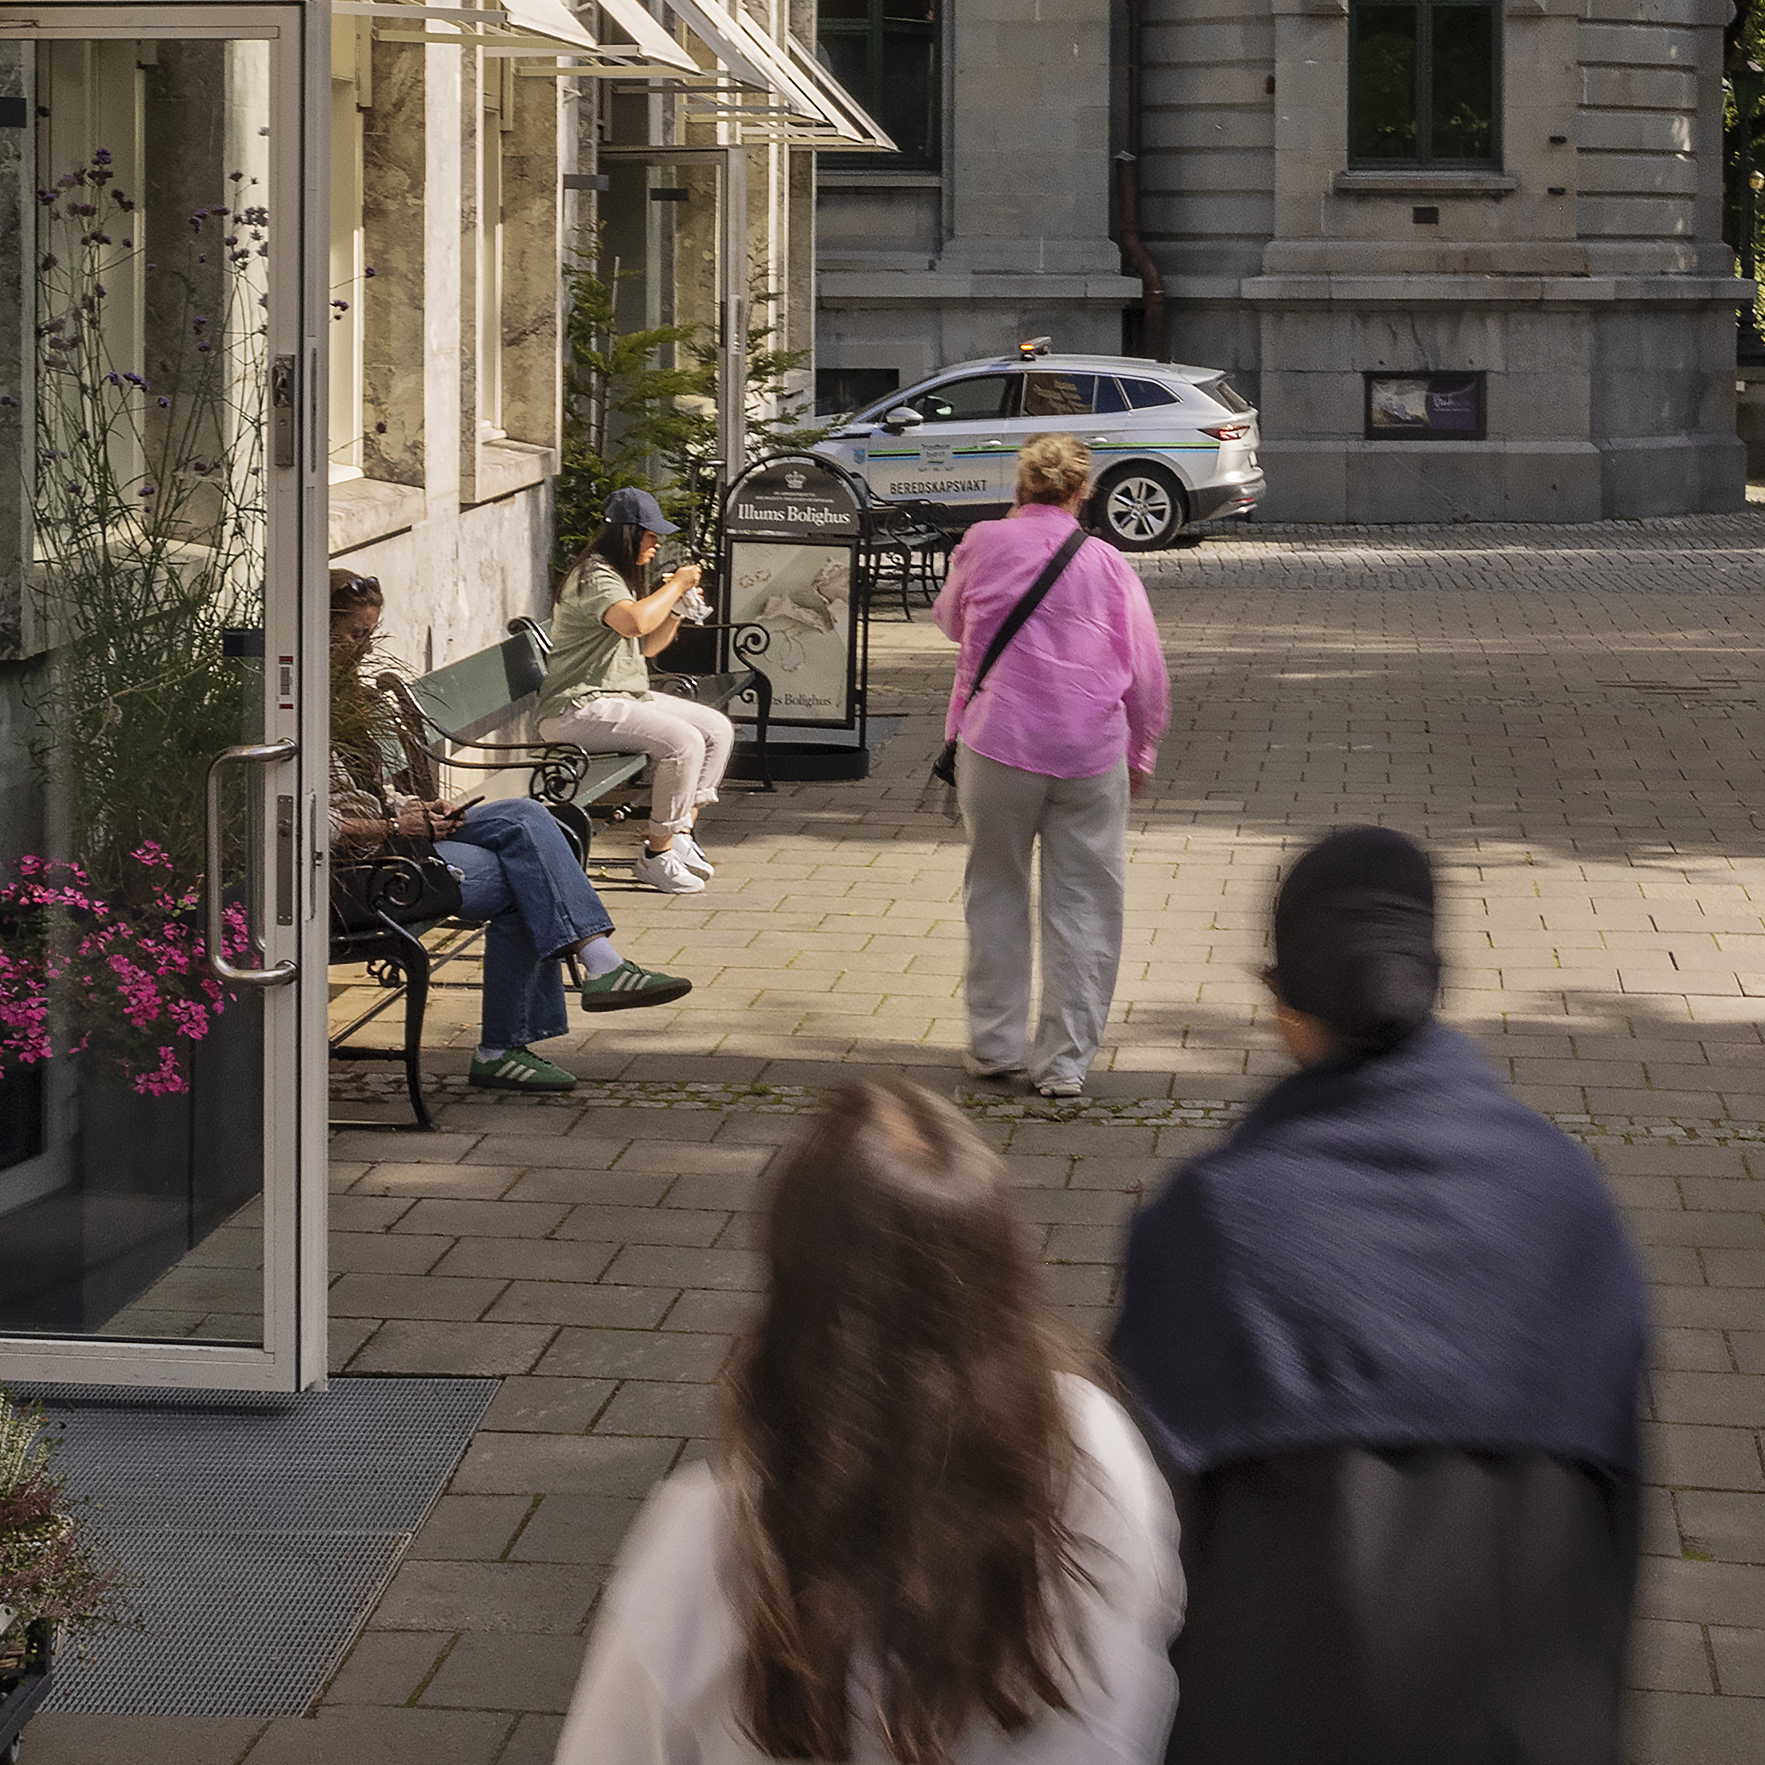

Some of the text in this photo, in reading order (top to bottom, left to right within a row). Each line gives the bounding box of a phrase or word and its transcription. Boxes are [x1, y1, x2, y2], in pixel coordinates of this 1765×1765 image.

[890, 479, 987, 495] BEREDSKAPSVAKT
[738, 503, 851, 527] Illums Bolighus
